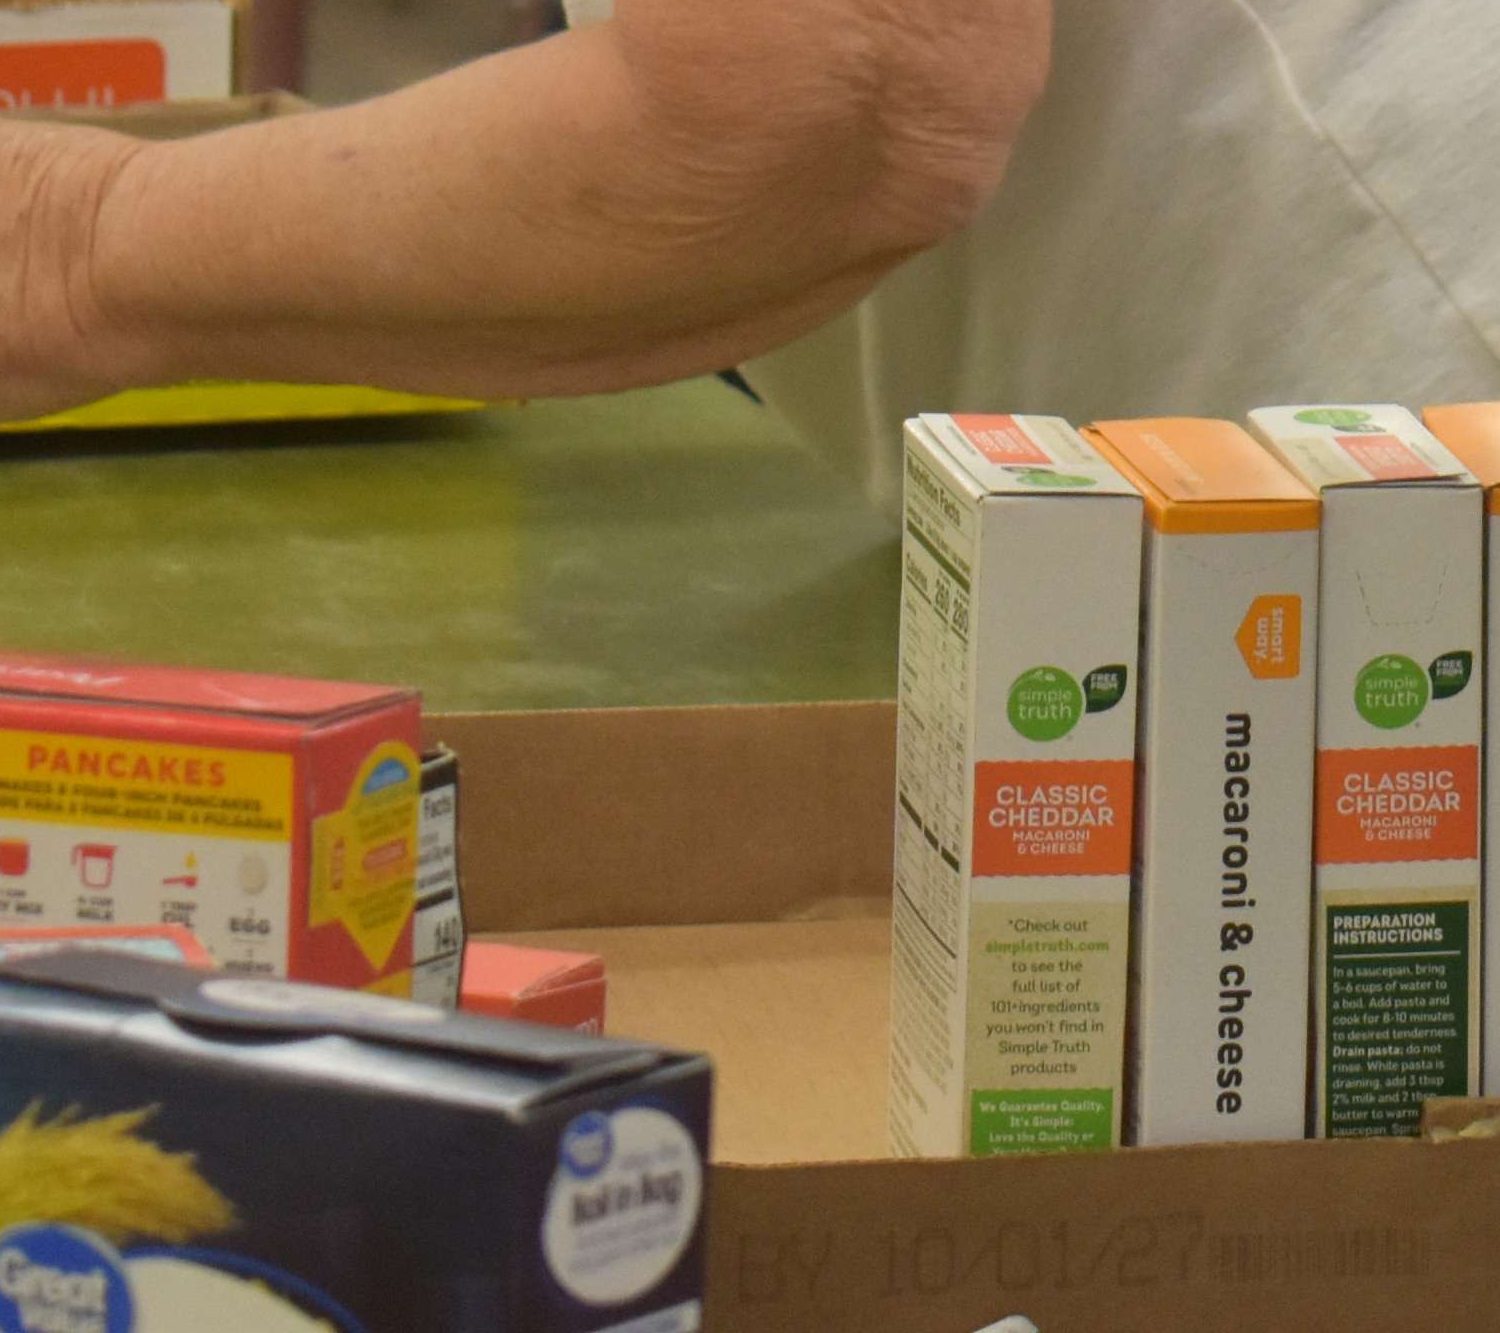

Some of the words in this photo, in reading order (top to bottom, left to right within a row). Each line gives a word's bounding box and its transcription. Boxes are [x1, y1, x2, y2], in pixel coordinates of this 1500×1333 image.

[1271, 607, 1285, 664] smart
[1435, 659, 1464, 669] FREE
[1090, 672, 1119, 684] FREE
[1364, 676, 1419, 694] simple
[1018, 687, 1073, 707] simple
[1364, 690, 1420, 709] truth
[1018, 701, 1073, 721] truth
[26, 743, 228, 789] PANCAKES
[1343, 770, 1455, 794] CLASSIC
[996, 784, 1109, 807] CLASSIC
[1335, 792, 1462, 815] CHEDDAR
[987, 806, 1115, 829] CHEDDAR
[1221, 711, 1256, 909] macaroni
[1359, 815, 1438, 829] MACARONI
[1011, 829, 1092, 842] MACARONI
[1377, 828, 1432, 841] CHEESE
[1029, 842, 1086, 855] CHEESE
[229, 916, 272, 936] EGG
[1062, 920, 1088, 933] out
[1332, 912, 1436, 931] PREPARATION
[1219, 921, 1254, 952] &
[1332, 927, 1444, 946] INSTRUCTIONS
[1011, 962, 1027, 973] to
[1030, 963, 1055, 974] see
[1058, 960, 1084, 973] the
[1332, 966, 1344, 978] In
[1414, 963, 1446, 978] bring
[1011, 978, 1036, 994] full
[1039, 978, 1062, 993] list
[1065, 978, 1082, 993] of
[1355, 982, 1383, 996] cups
[1384, 980, 1397, 993] of
[1399, 981, 1433, 992] water
[1435, 979, 1448, 991] to
[1367, 995, 1392, 1009] Add
[1394, 997, 1427, 1012] pasta
[1427, 994, 1451, 1007] and
[1332, 1013, 1361, 1027] cook
[1362, 1012, 1380, 1025] for
[1382, 1010, 1408, 1025] 8-10
[1409, 1010, 1456, 1024] minutes
[986, 1024, 1014, 1036] you
[1016, 1021, 1056, 1035] won't
[1058, 1019, 1088, 1034] find
[1091, 1019, 1105, 1033] in
[1332, 1031, 1346, 1043] to
[1347, 1028, 1391, 1043] desired
[1215, 962, 1253, 1115] cheese
[998, 1038, 1050, 1057] Simple
[1052, 1038, 1092, 1054] Truth
[1332, 1045, 1365, 1058] Drain
[1405, 1043, 1420, 1057] do
[1422, 1043, 1443, 1056] not
[1010, 1059, 1078, 1076] products
[1366, 1059, 1400, 1075] While
[1401, 1063, 1434, 1079] pasta
[1435, 1059, 1445, 1072] is
[1384, 1074, 1407, 1089] add
[1332, 1092, 1349, 1106] 2%
[1351, 1090, 1377, 1106] milk
[1377, 1090, 1401, 1105] and
[1402, 1090, 1410, 1103] 2
[1332, 1107, 1367, 1122] butter
[1370, 1106, 1384, 1120] to
[1386, 1108, 1419, 1120] warm
